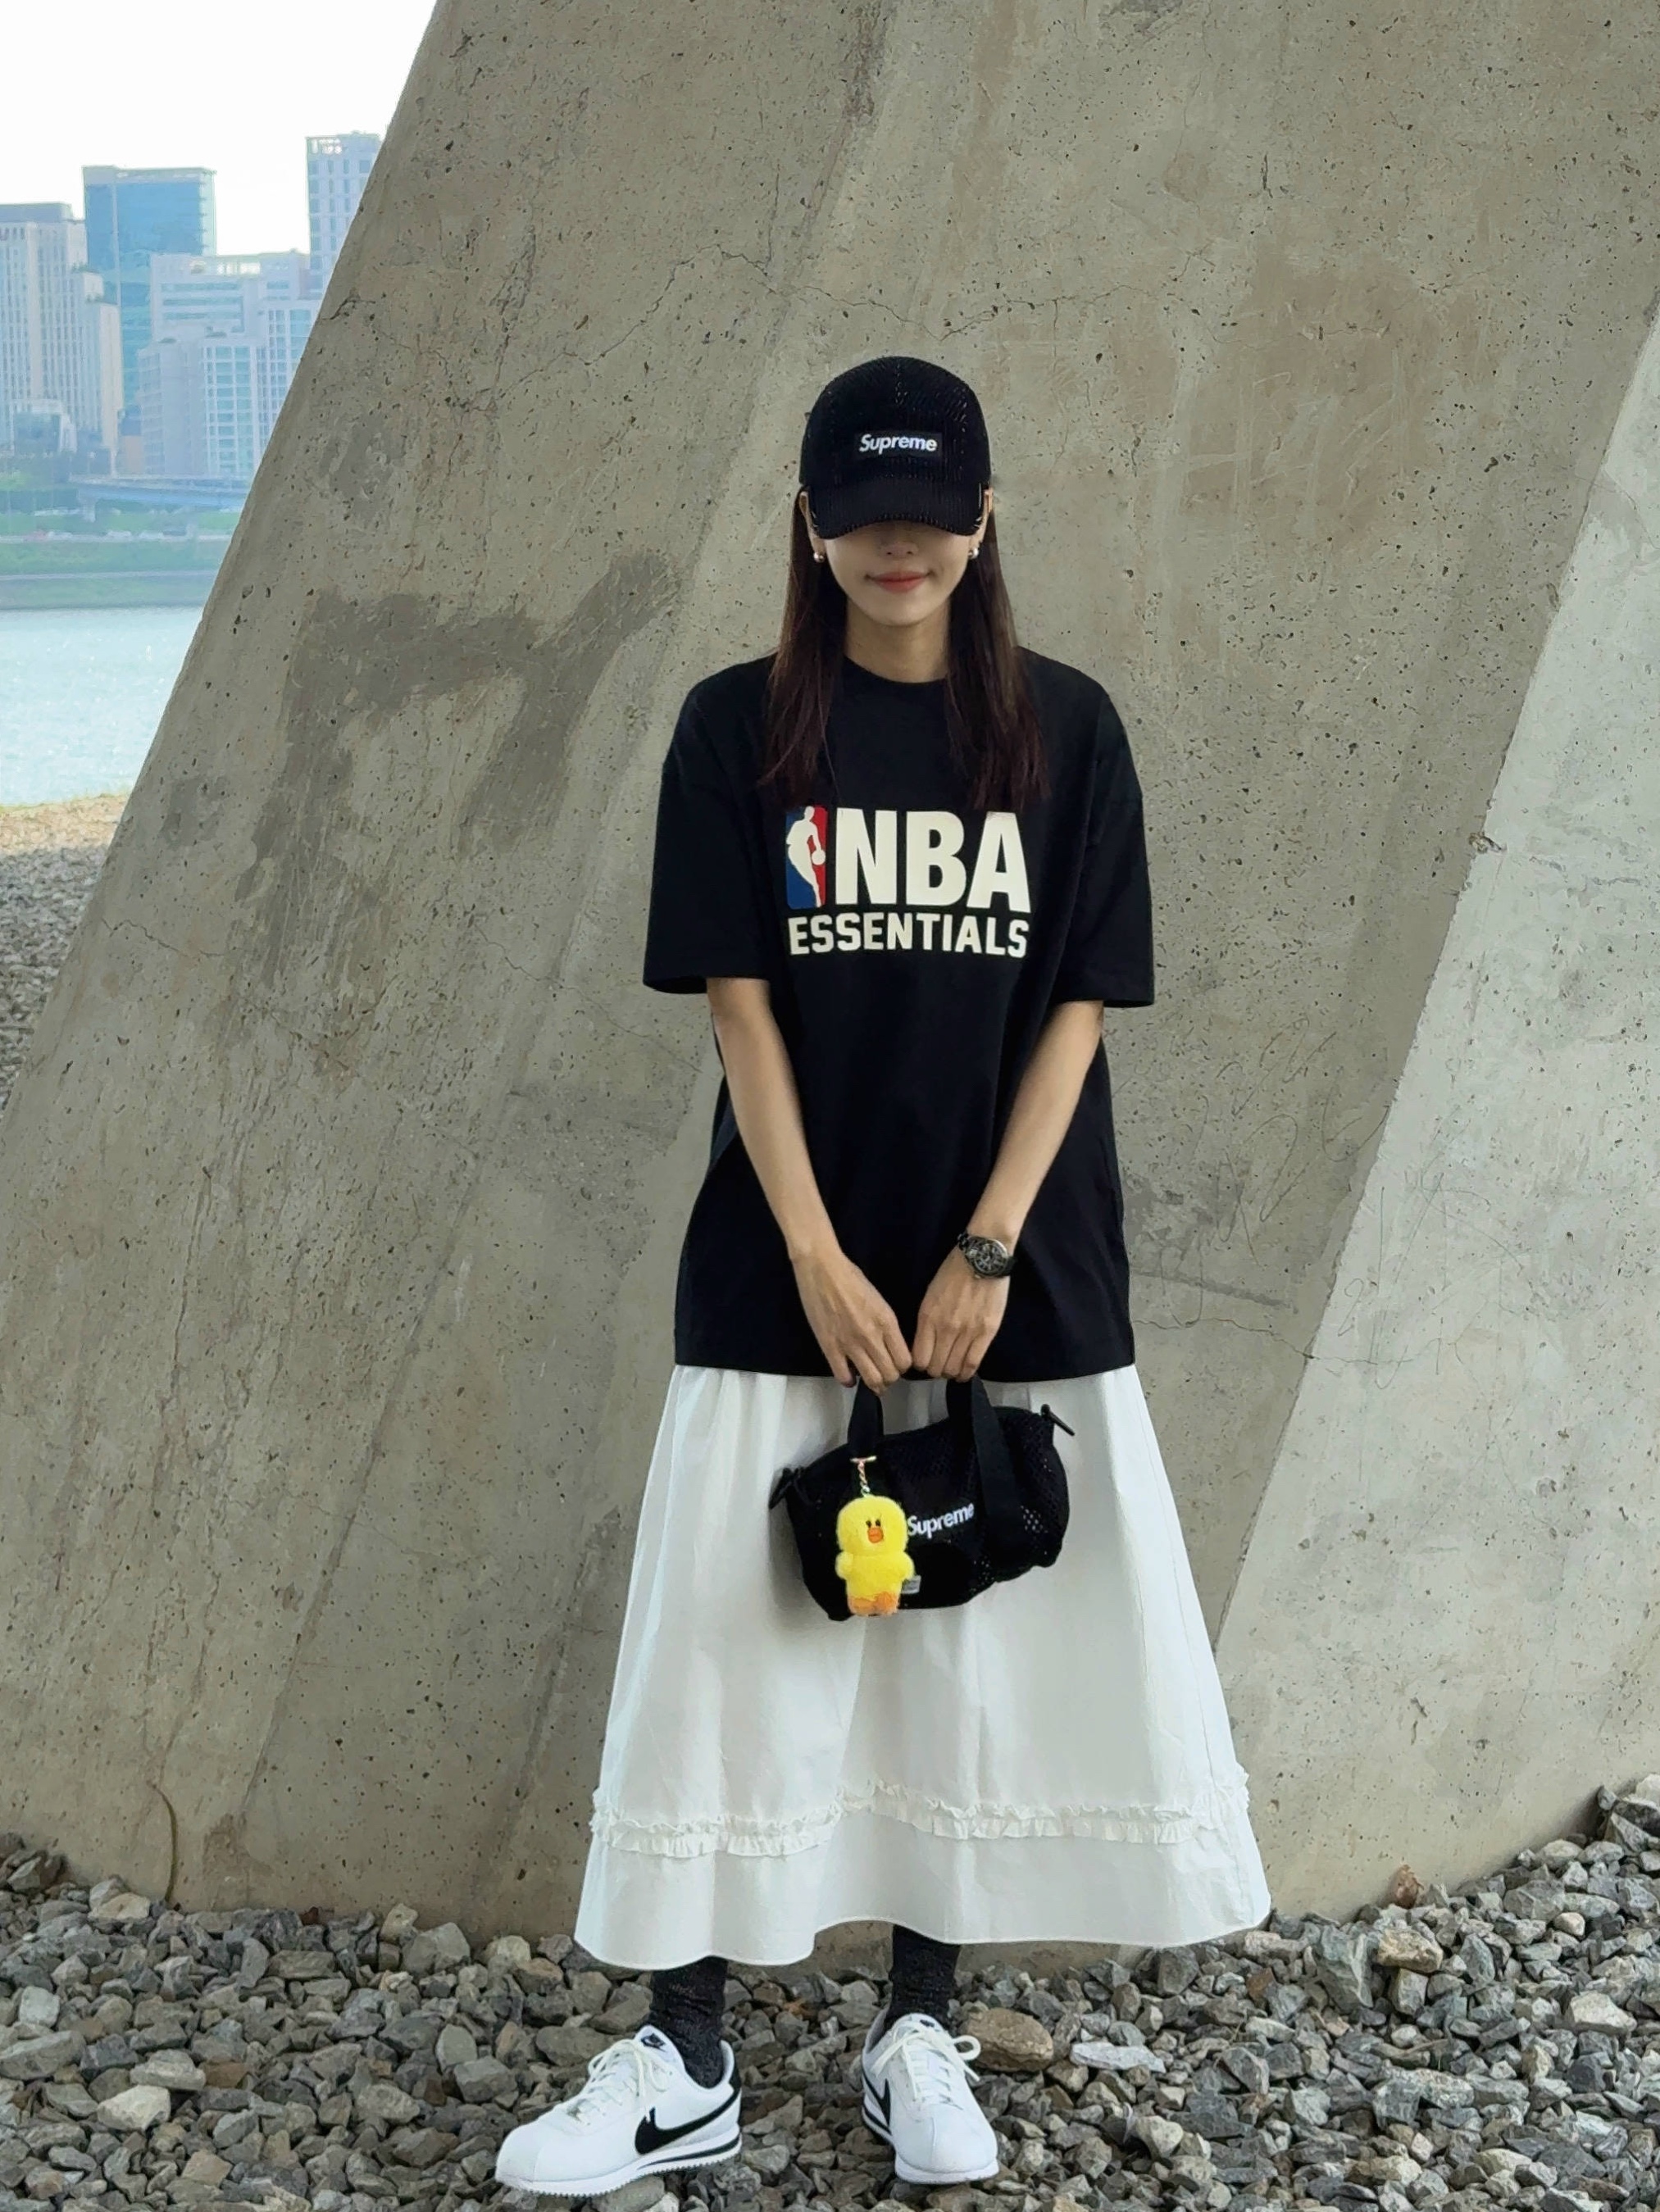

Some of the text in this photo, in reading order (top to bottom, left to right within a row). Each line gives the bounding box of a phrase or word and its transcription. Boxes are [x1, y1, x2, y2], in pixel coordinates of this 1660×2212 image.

[858, 434, 938, 455] Supreme
[835, 807, 1031, 914] NBA
[788, 911, 1030, 959] ESSENTIALS
[907, 1502, 975, 1539] Supreme
